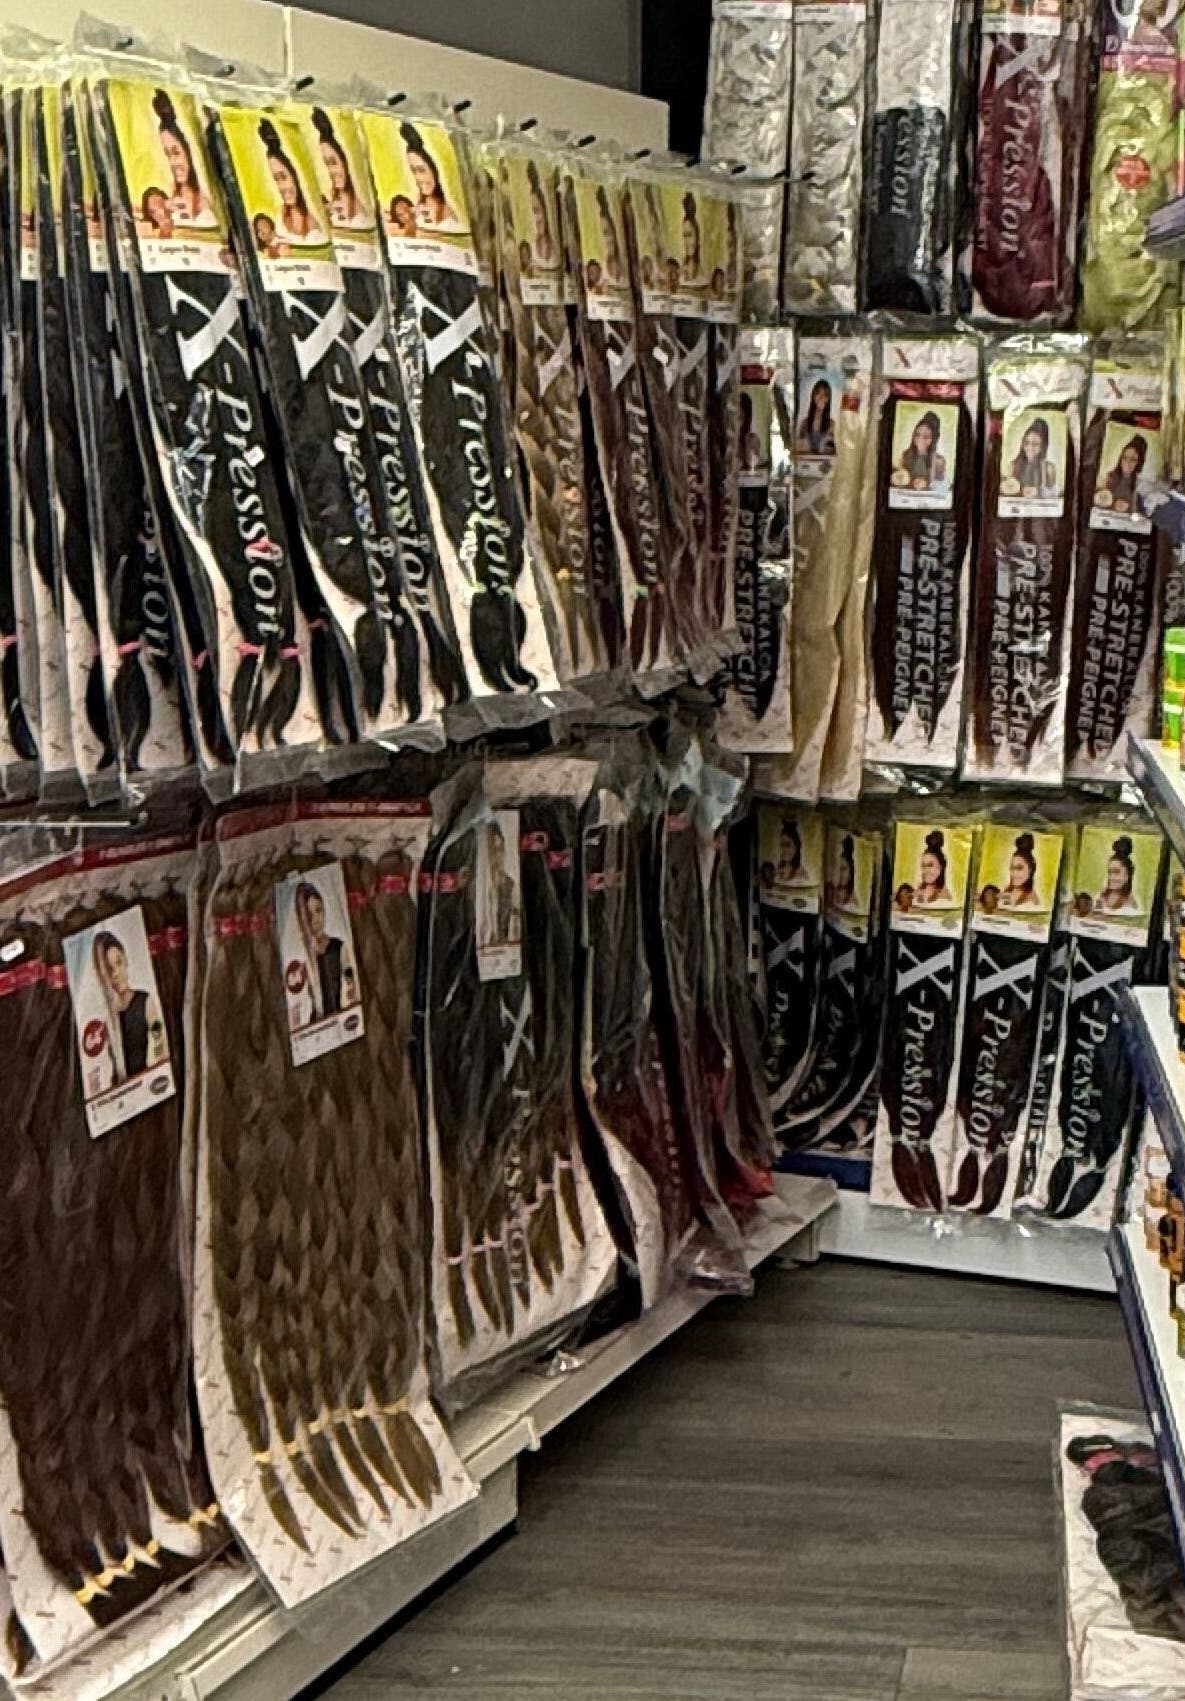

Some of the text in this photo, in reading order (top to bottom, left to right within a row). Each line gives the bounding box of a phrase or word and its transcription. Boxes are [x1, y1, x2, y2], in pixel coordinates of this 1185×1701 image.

[895, 936, 955, 1149] X-Pression
[970, 942, 1038, 1151] X-Pression
[1064, 944, 1135, 1158] X-Pression
